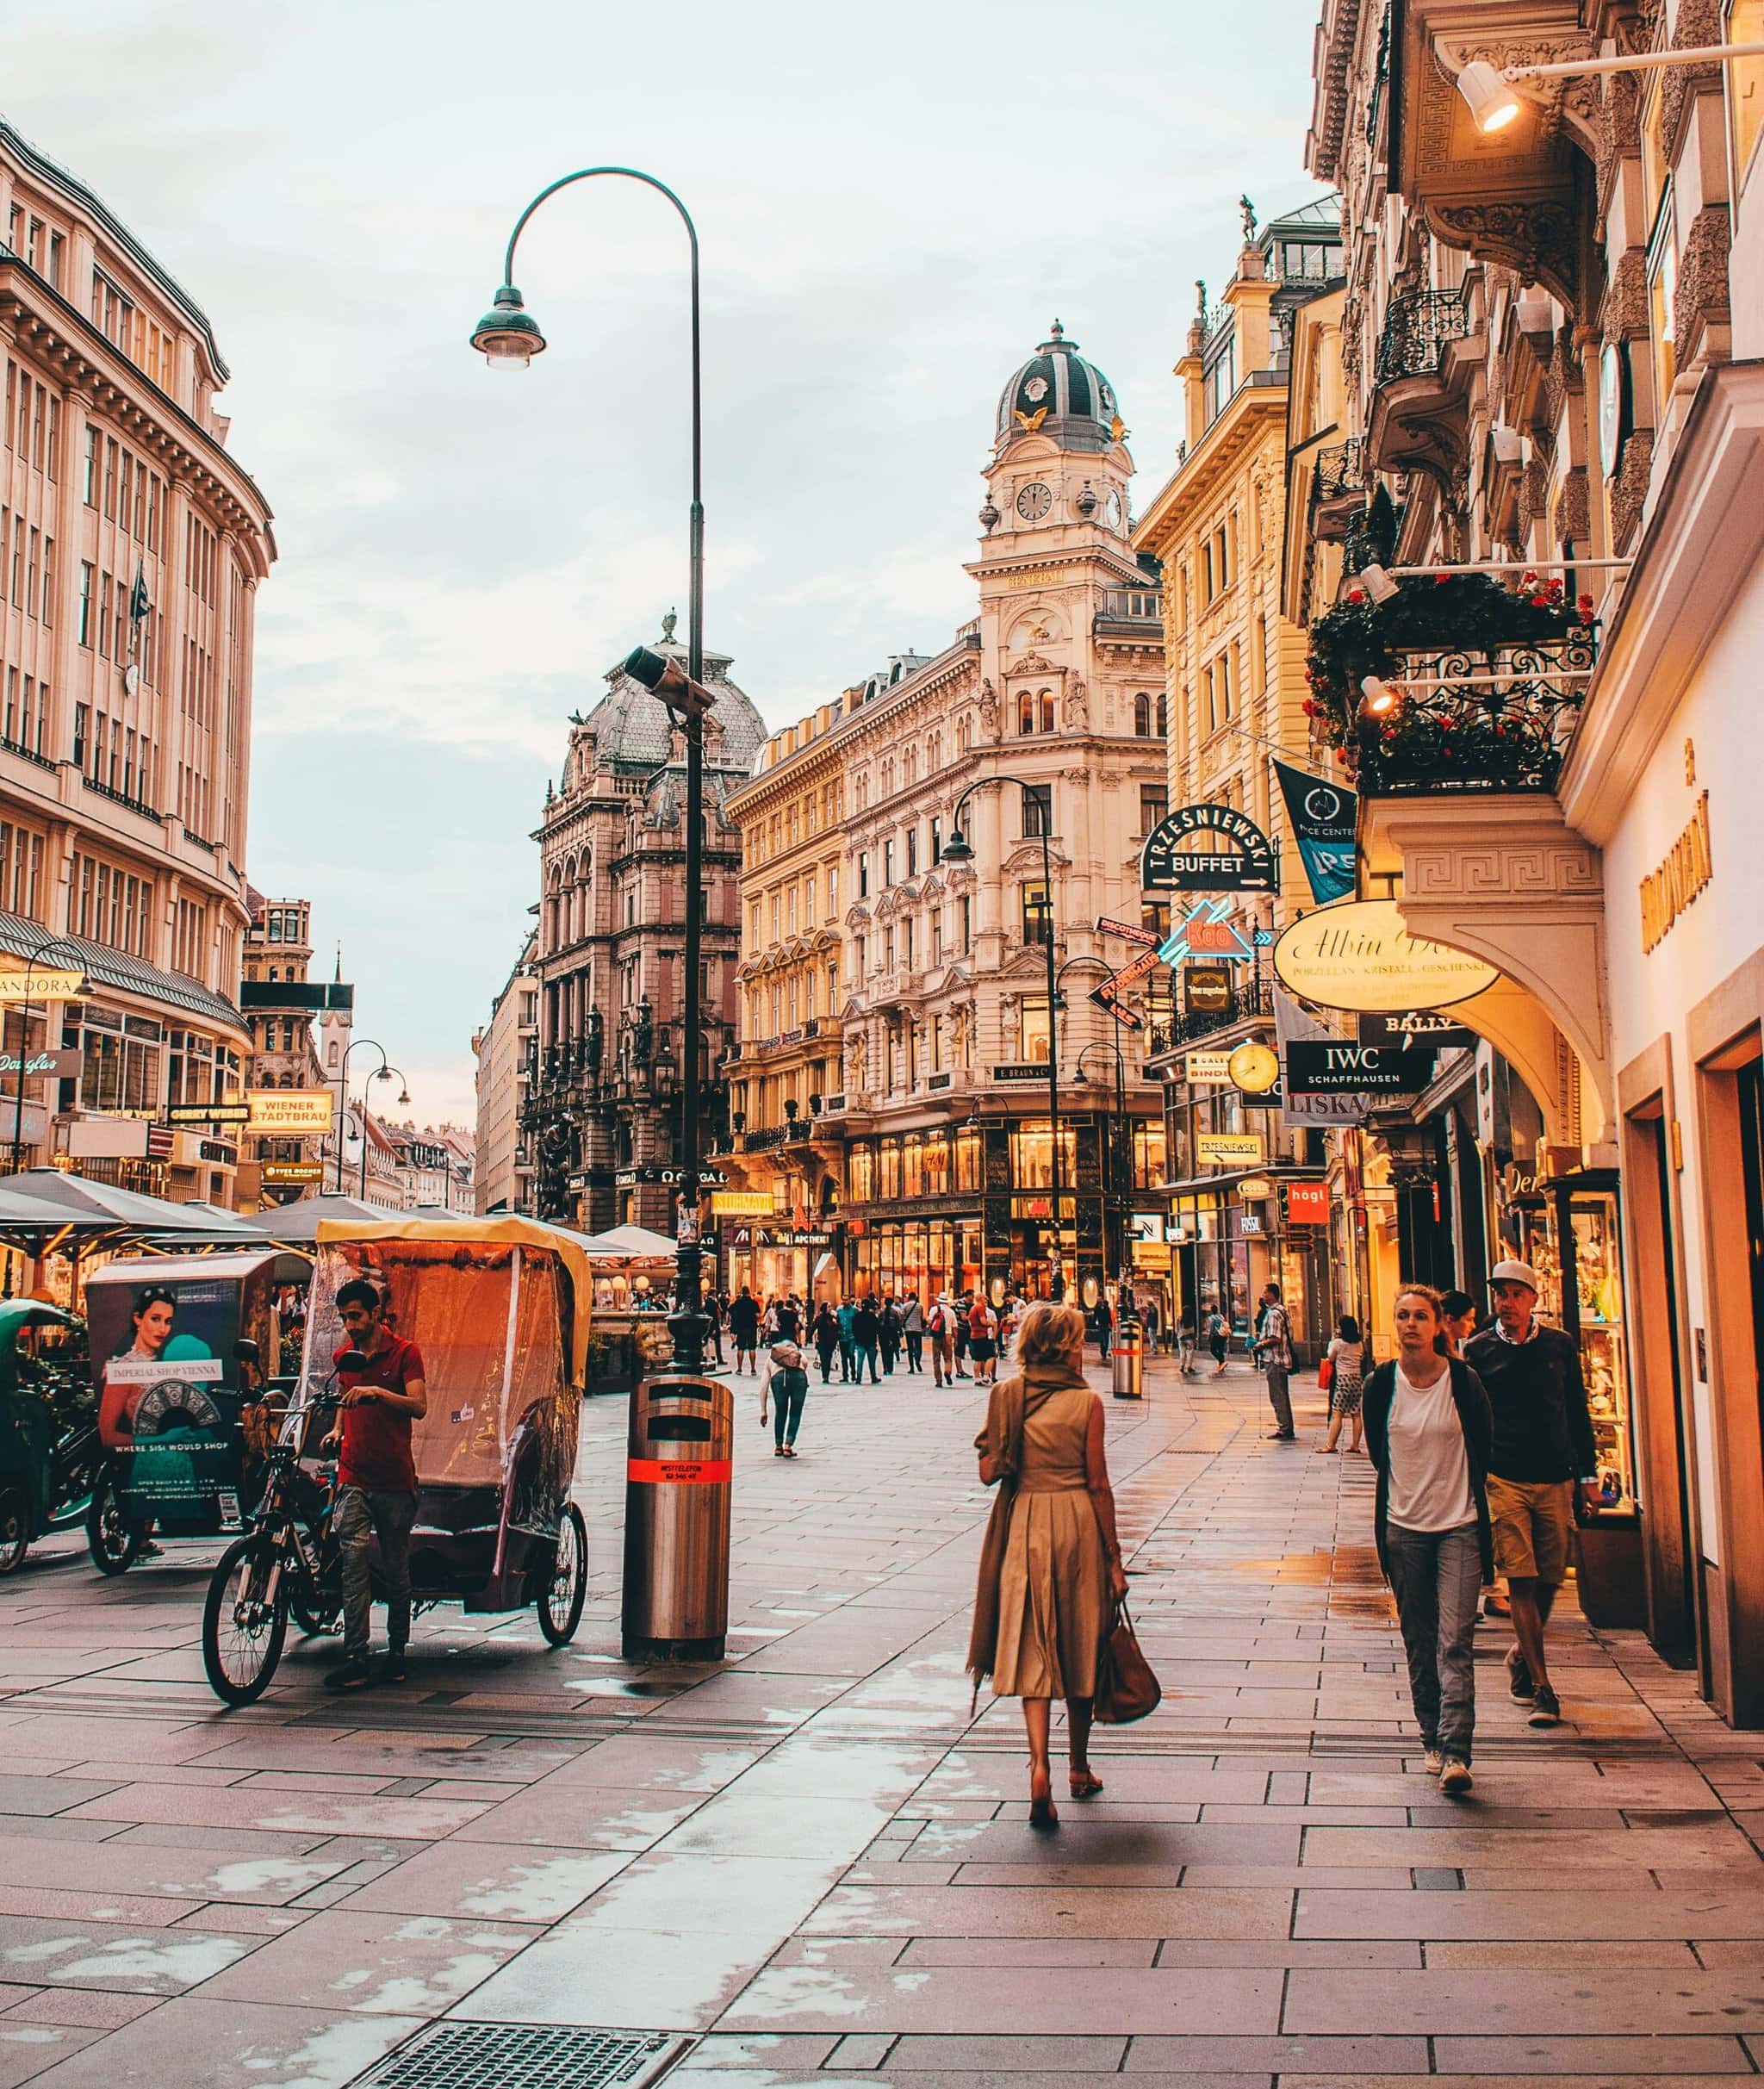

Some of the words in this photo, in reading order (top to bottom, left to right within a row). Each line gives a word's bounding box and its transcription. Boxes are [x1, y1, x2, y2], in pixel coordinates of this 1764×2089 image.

[1172, 857, 1245, 872] BUFFET
[1293, 929, 1385, 959] Albin
[1364, 964, 1413, 974] KRISTALL
[1386, 1017, 1452, 1033] BALLY
[1326, 1048, 1379, 1069] IWC
[1009, 1068, 1033, 1077] BRAUN
[1308, 1075, 1400, 1084] SCHAFFHAUSEN
[1289, 1095, 1366, 1114] LISKA
[676, 1172, 717, 1183] OGA
[114, 1368, 153, 1378] IMPERIAL
[157, 1366, 180, 1377] SHOP
[182, 1365, 215, 1376] VIENNA
[115, 1445, 146, 1453] WHERE
[169, 1443, 202, 1452] WOULD
